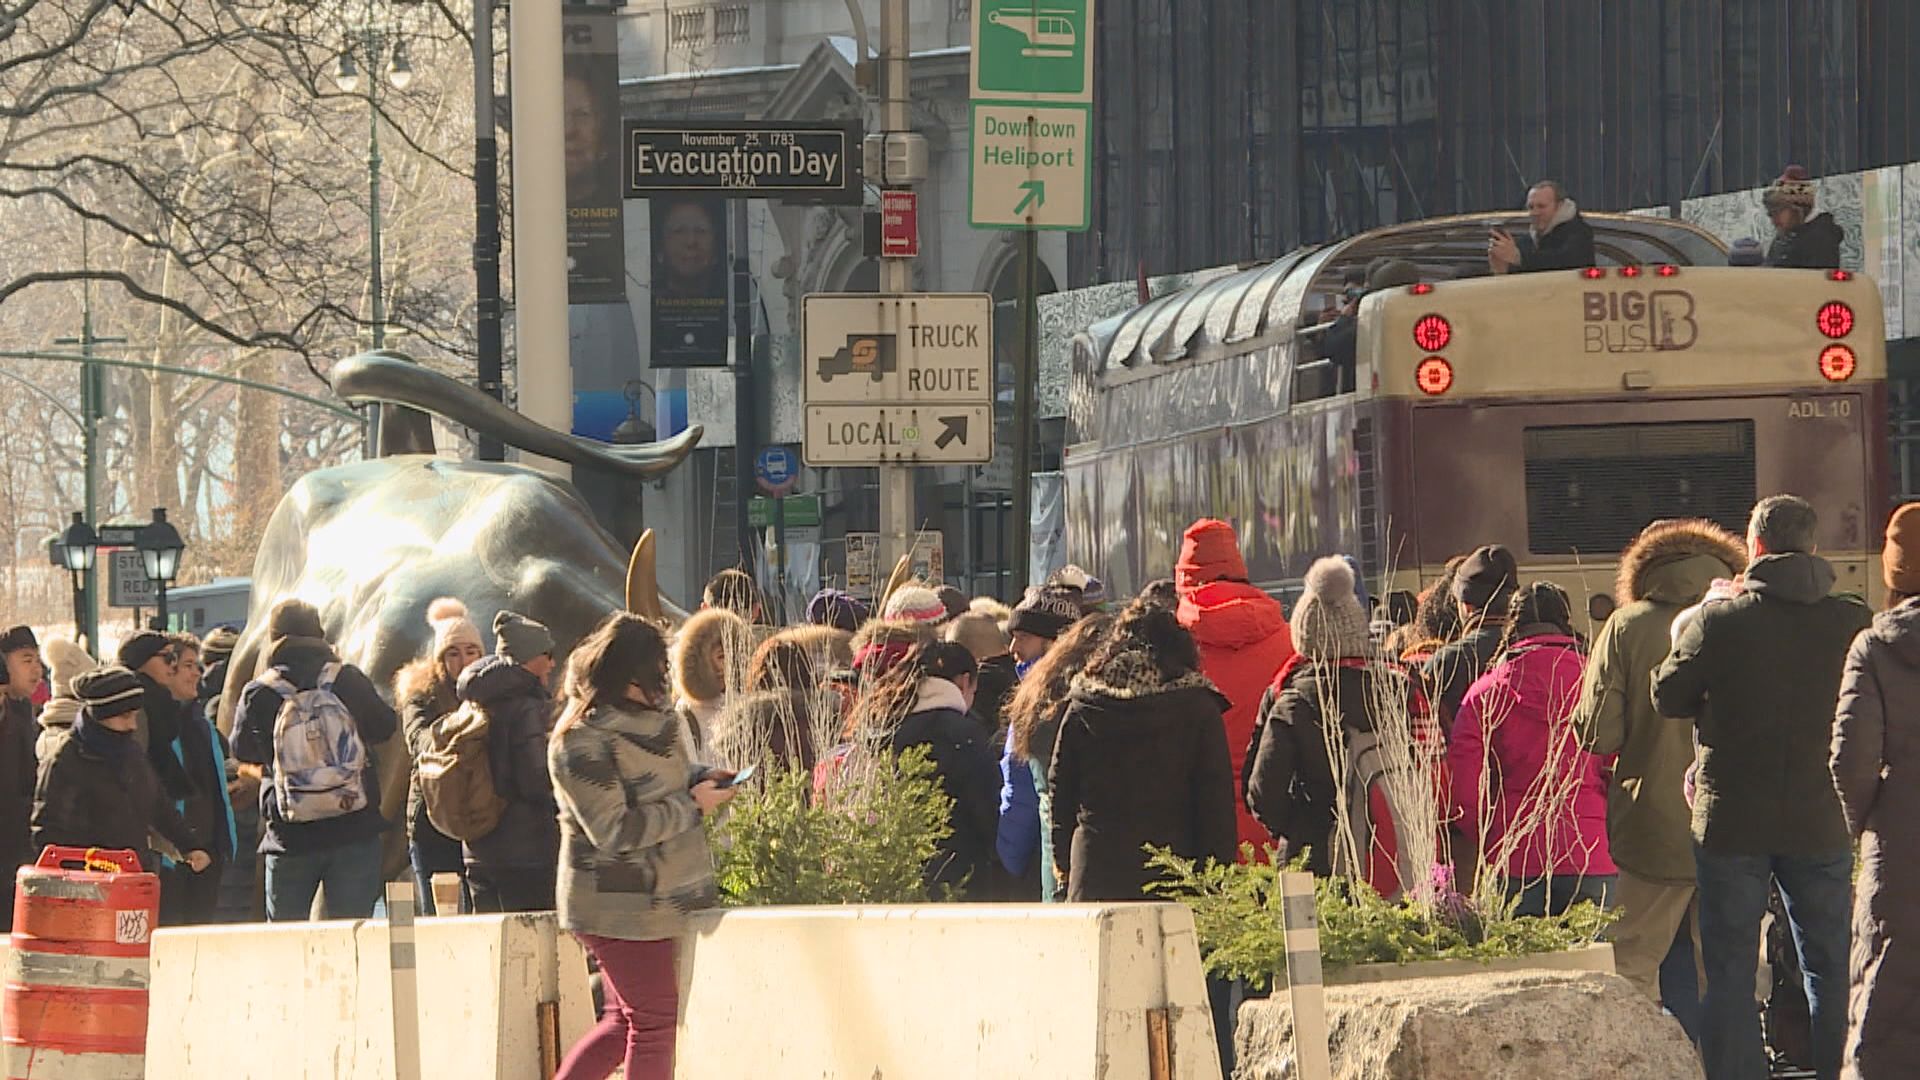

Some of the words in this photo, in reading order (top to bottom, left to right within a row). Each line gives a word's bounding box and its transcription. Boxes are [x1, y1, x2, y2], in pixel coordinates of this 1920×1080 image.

[984, 115, 1076, 138] Downtown
[681, 133, 737, 146] November
[770, 133, 795, 146] 1783
[637, 145, 782, 175] Evacuation
[789, 145, 838, 182] Day
[983, 145, 1075, 169] Heliport
[720, 174, 757, 187] PLAZA
[1583, 290, 1646, 322] BIG
[908, 324, 979, 348] TRUCK
[1584, 324, 1647, 353] BUS
[908, 368, 980, 392] ROUTE
[1788, 400, 1825, 418] ADL
[1830, 399, 1851, 417] 10
[827, 422, 902, 446] LOCAL
[119, 556, 144, 569] STO
[122, 580, 151, 593] RED
